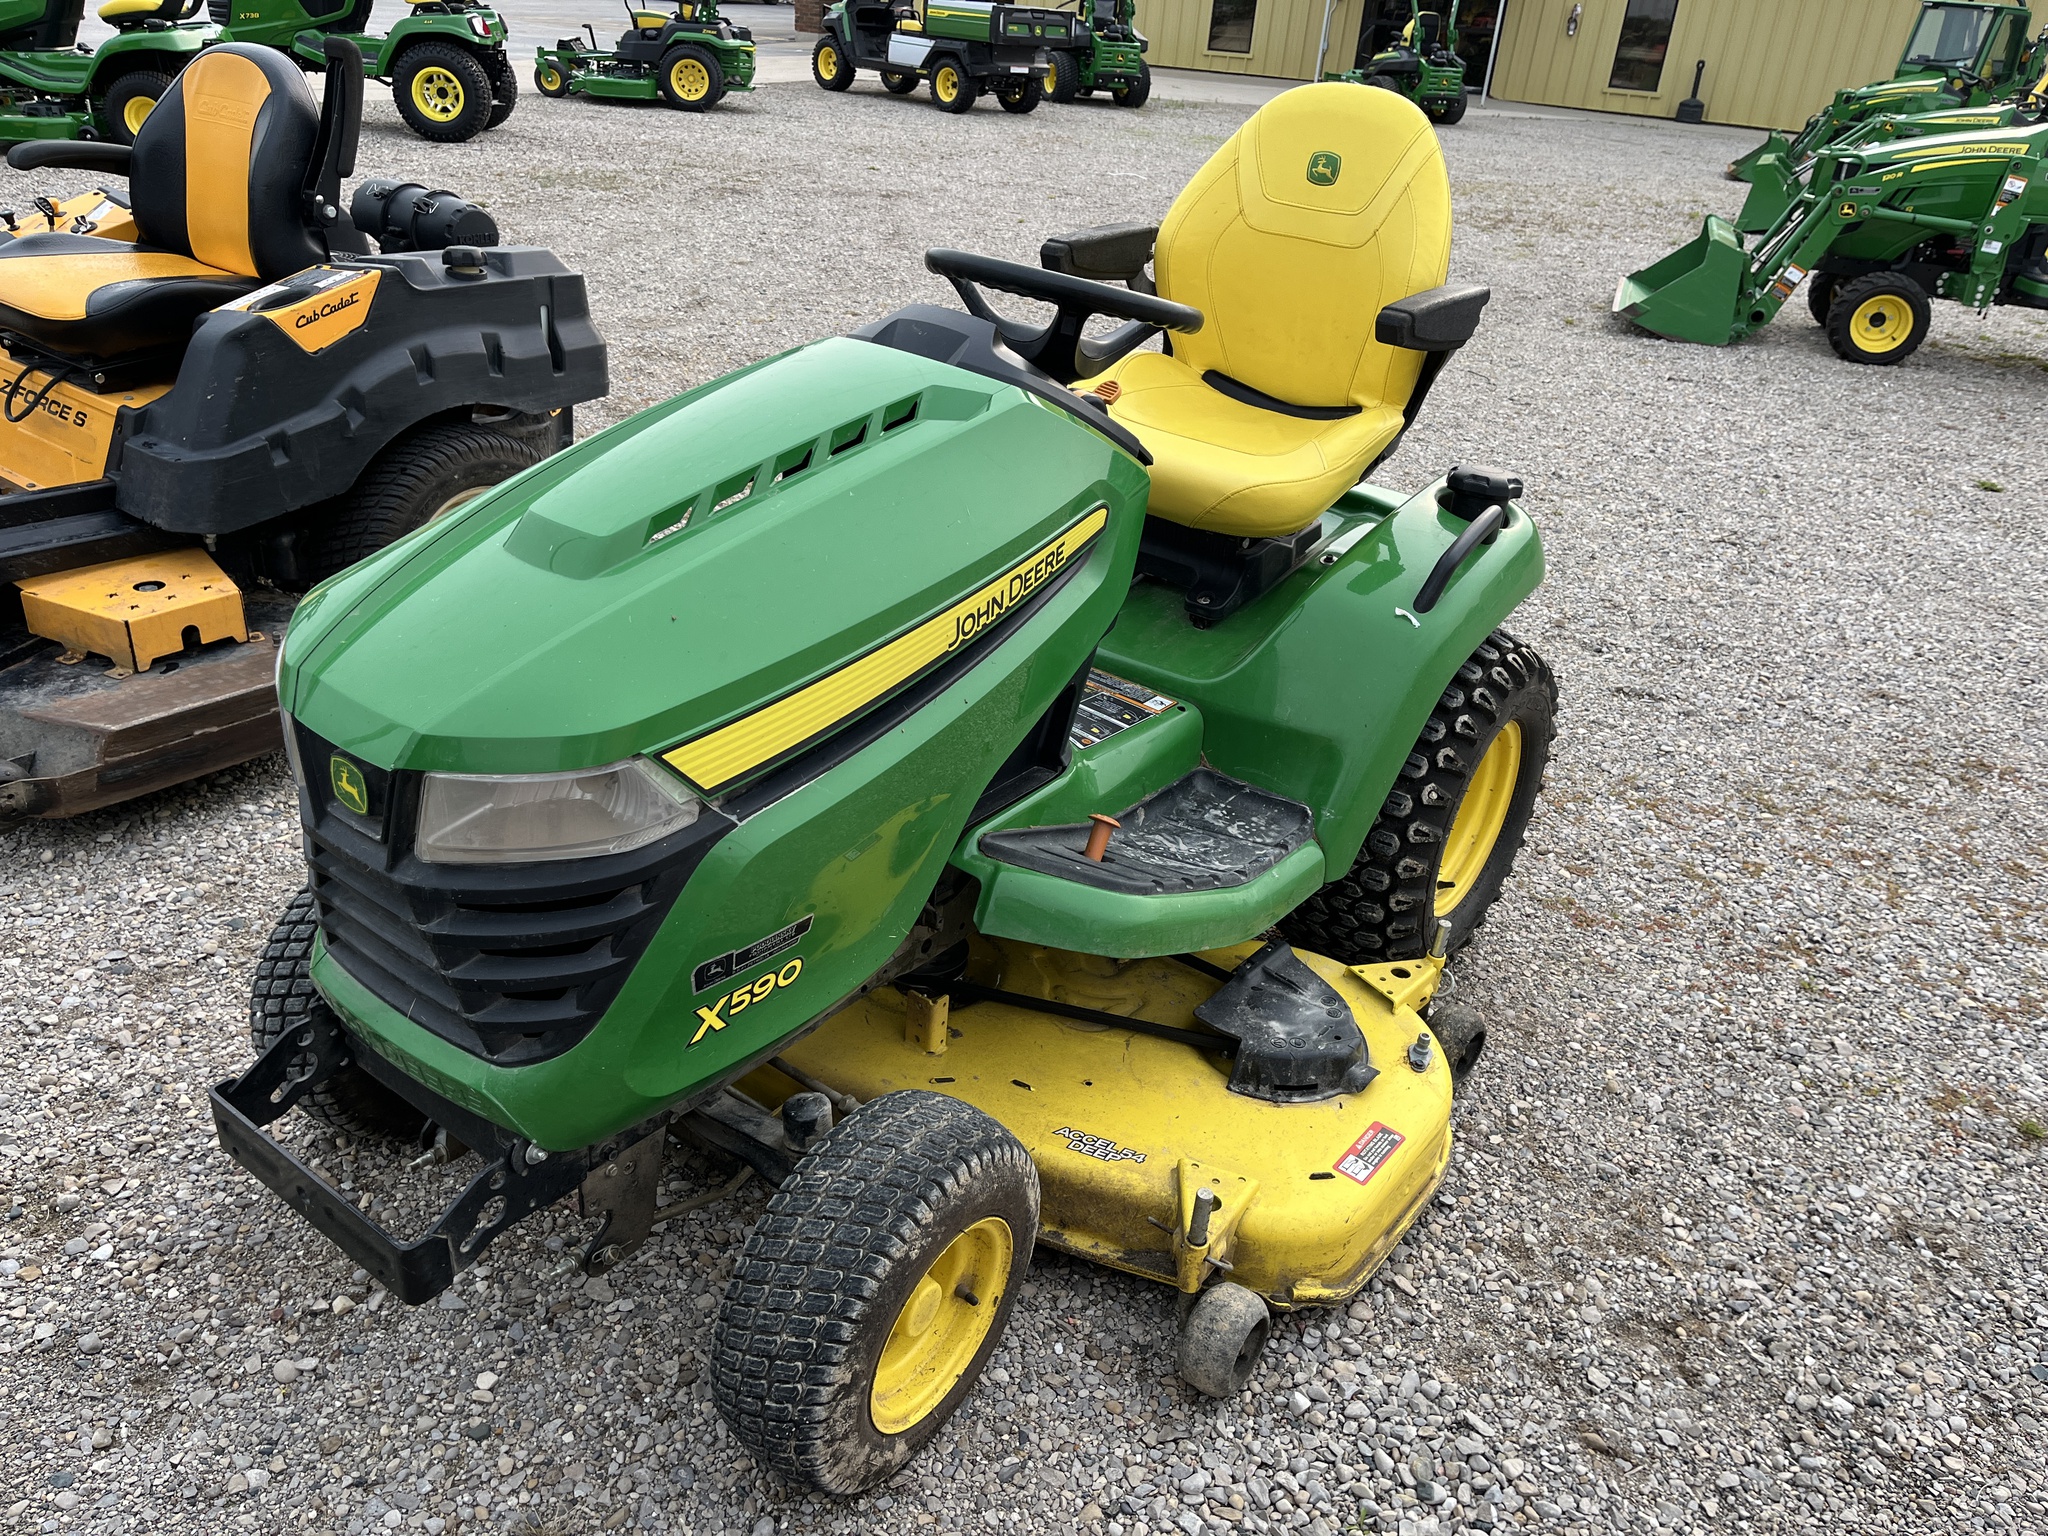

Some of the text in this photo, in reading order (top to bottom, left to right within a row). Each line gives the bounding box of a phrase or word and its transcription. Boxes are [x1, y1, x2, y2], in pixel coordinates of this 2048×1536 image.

[1959, 145, 2023, 155] JOHN DEERE
[458, 232, 496, 245] KOHLER
[295, 291, 360, 329] Cub Cadet
[73, 410, 88, 427] S
[947, 540, 1067, 651] JOHN DEERE
[685, 956, 804, 1049] X590
[1051, 1126, 1148, 1164] ACCEL 54
[1357, 1128, 1376, 1148] DANGER
[1066, 1140, 1122, 1162] DEEP
